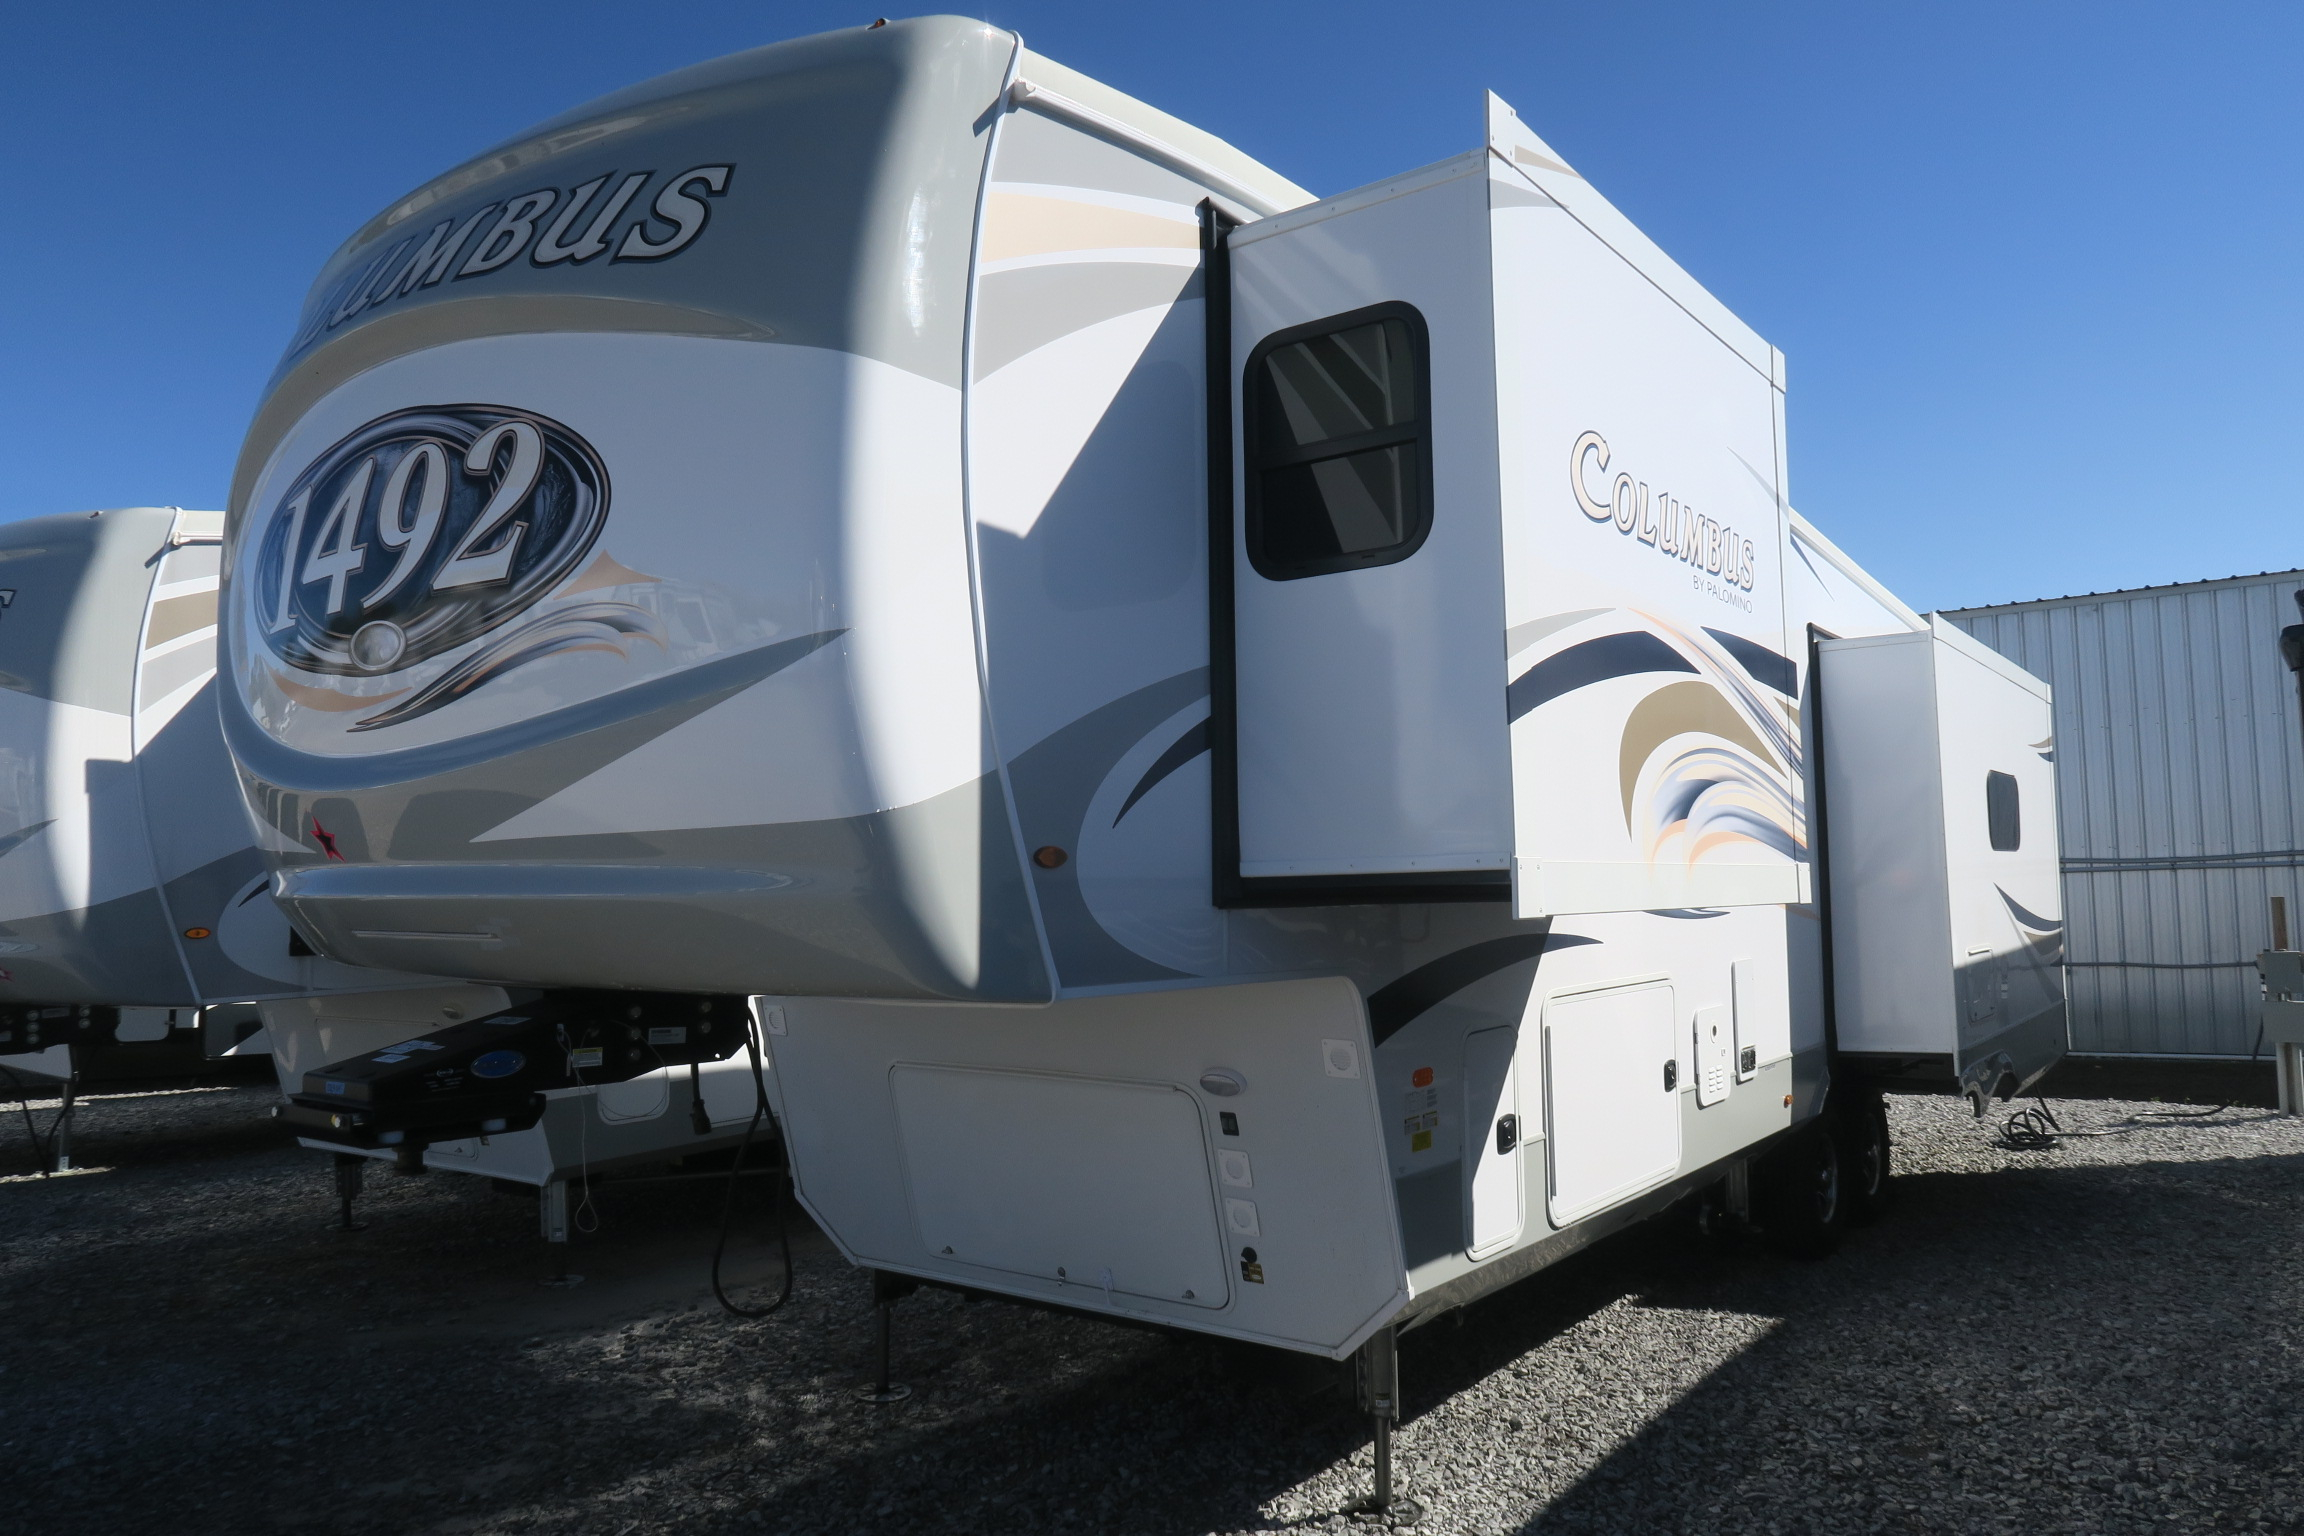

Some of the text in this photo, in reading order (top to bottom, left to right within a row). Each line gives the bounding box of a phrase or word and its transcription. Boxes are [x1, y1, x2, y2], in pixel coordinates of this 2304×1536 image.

[268, 418, 546, 636] 1492
[1571, 430, 1754, 592] COLUMBUS
[1693, 574, 1753, 614] BY PALOMINO
